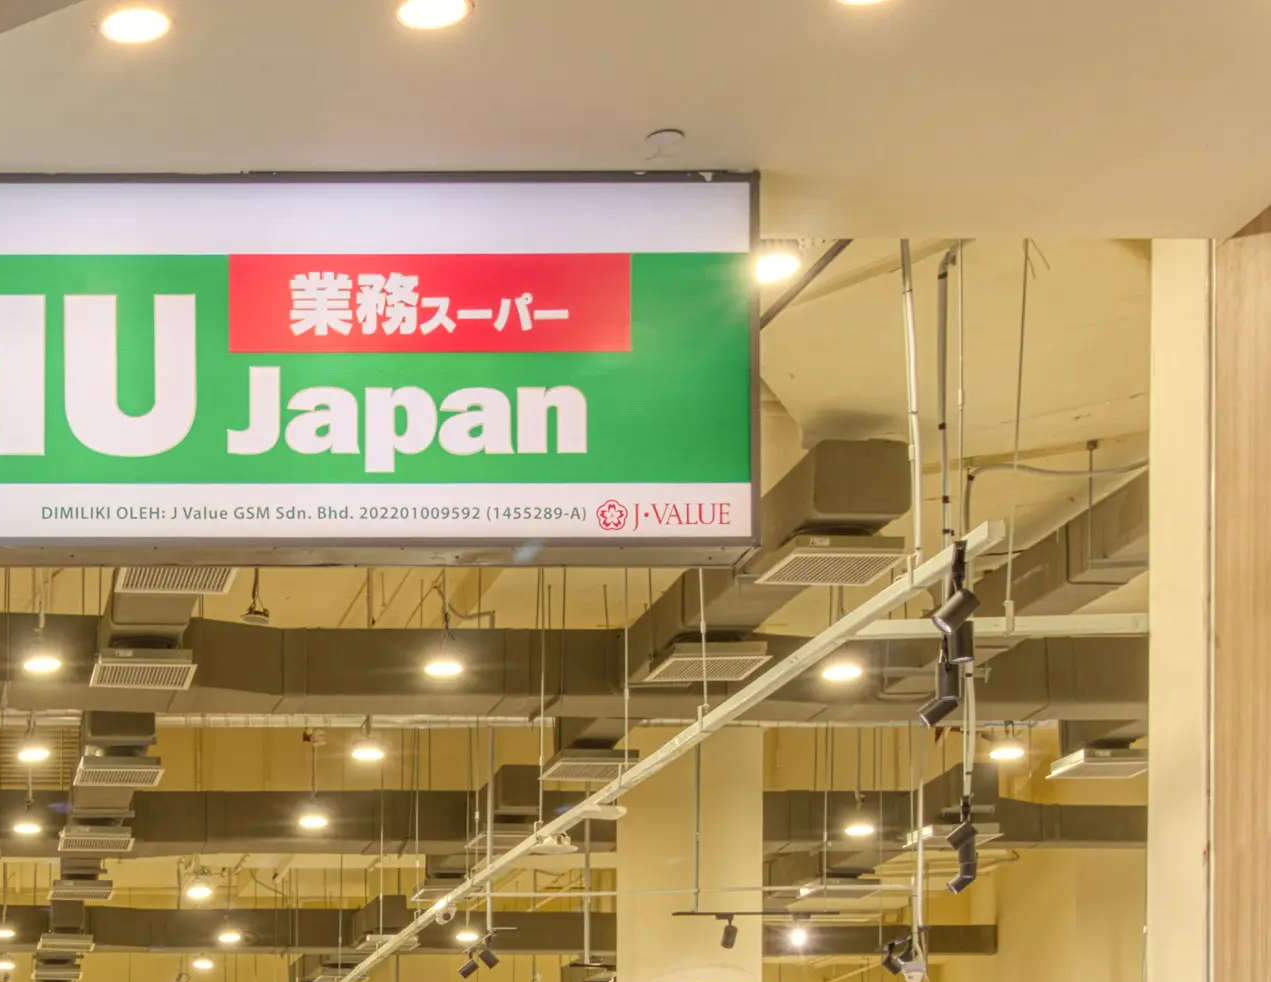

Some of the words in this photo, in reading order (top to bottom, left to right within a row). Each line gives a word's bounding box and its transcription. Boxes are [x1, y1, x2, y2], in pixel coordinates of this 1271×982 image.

[289, 271, 569, 337] 業務スーパー
[227, 366, 587, 473] Japan
[41, 506, 110, 521] DIMILIKI
[116, 506, 165, 521] OLEH:
[171, 506, 177, 521] J
[183, 506, 228, 521] Value
[233, 506, 270, 521] GSM
[276, 506, 312, 521] Sdn.
[317, 506, 354, 521] Bhd.
[359, 506, 480, 521] 202201009592
[486, 505, 587, 523] (1455289-A)
